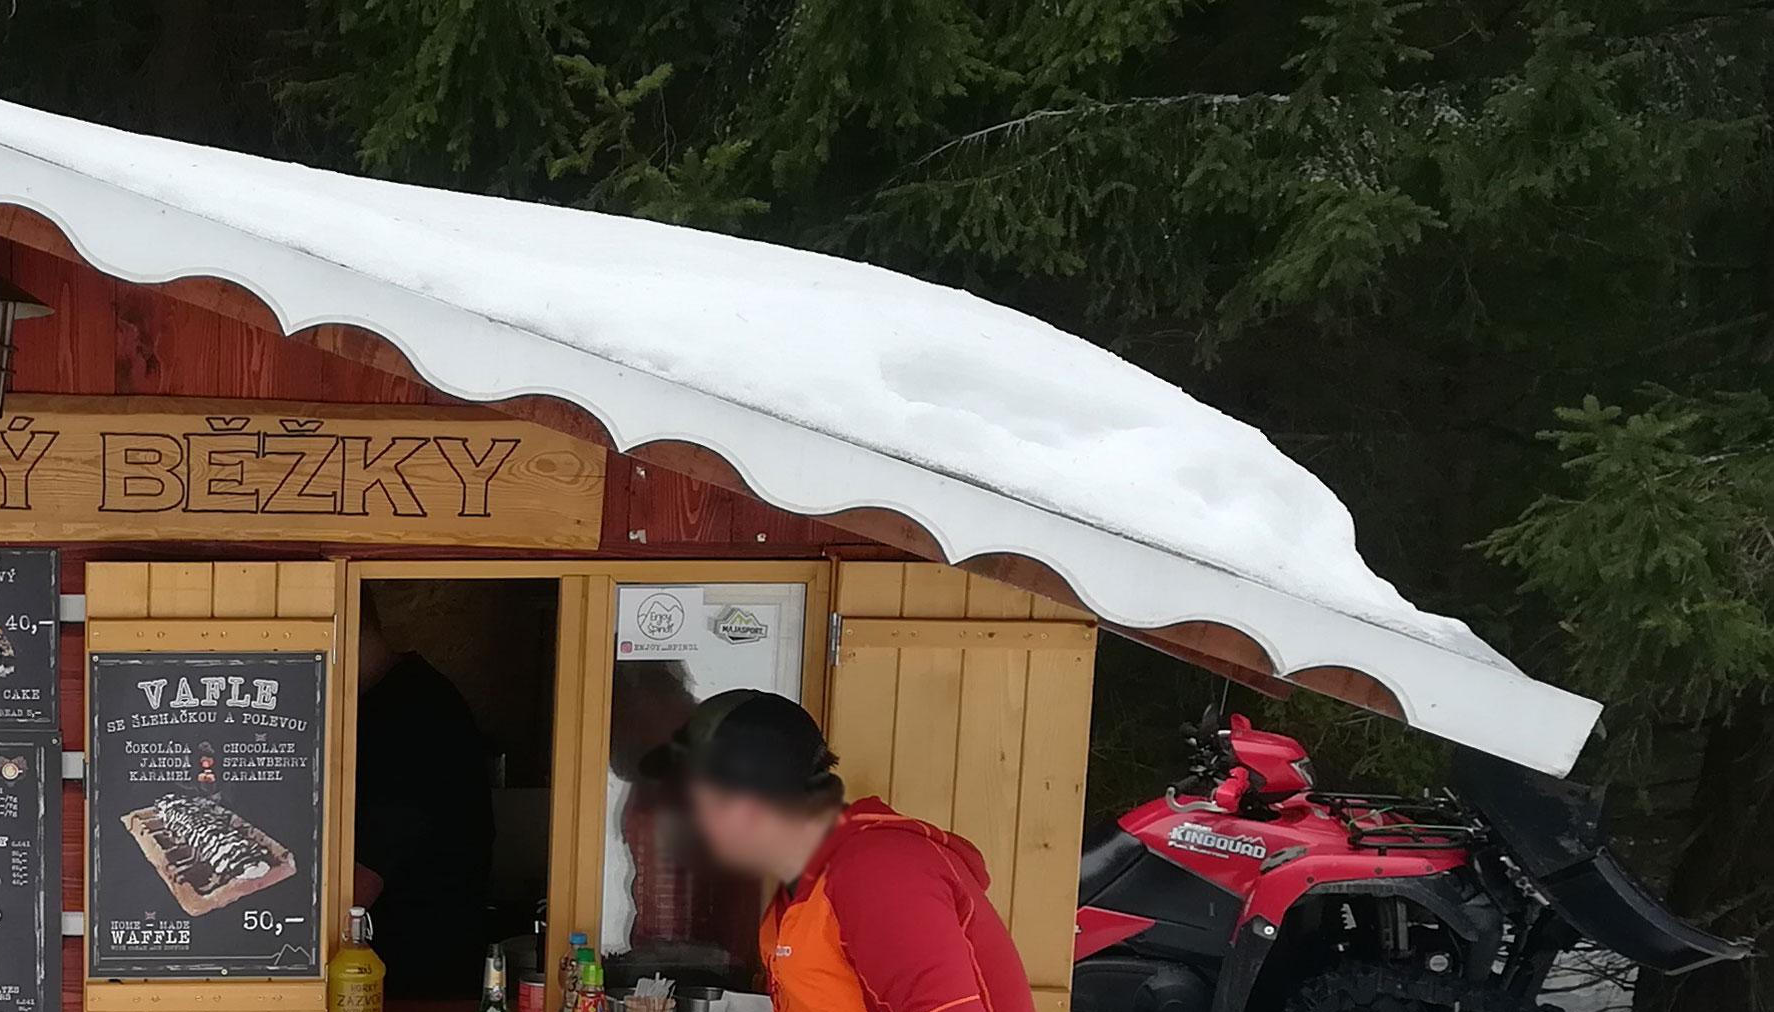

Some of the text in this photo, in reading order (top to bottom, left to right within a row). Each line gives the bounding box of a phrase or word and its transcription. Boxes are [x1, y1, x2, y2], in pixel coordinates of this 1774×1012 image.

[98, 414, 523, 520] BĚŽKY
[3, 689, 41, 701] CAKE
[137, 676, 280, 711] VAFLE
[107, 710, 308, 733] SE ŠLEHAČKOU A POLEVOU
[125, 741, 192, 755] ČOKOLÁDA
[222, 743, 296, 755] CHOCOLATE
[140, 757, 192, 769] JAHODA
[222, 757, 308, 768] STRAWBERRY
[129, 771, 192, 782] KARAMEL
[222, 771, 284, 782] CARAMEL
[1169, 827, 1267, 860] KINGQUAD
[111, 920, 191, 930] HOME MADE
[111, 930, 191, 945] WAFFLE
